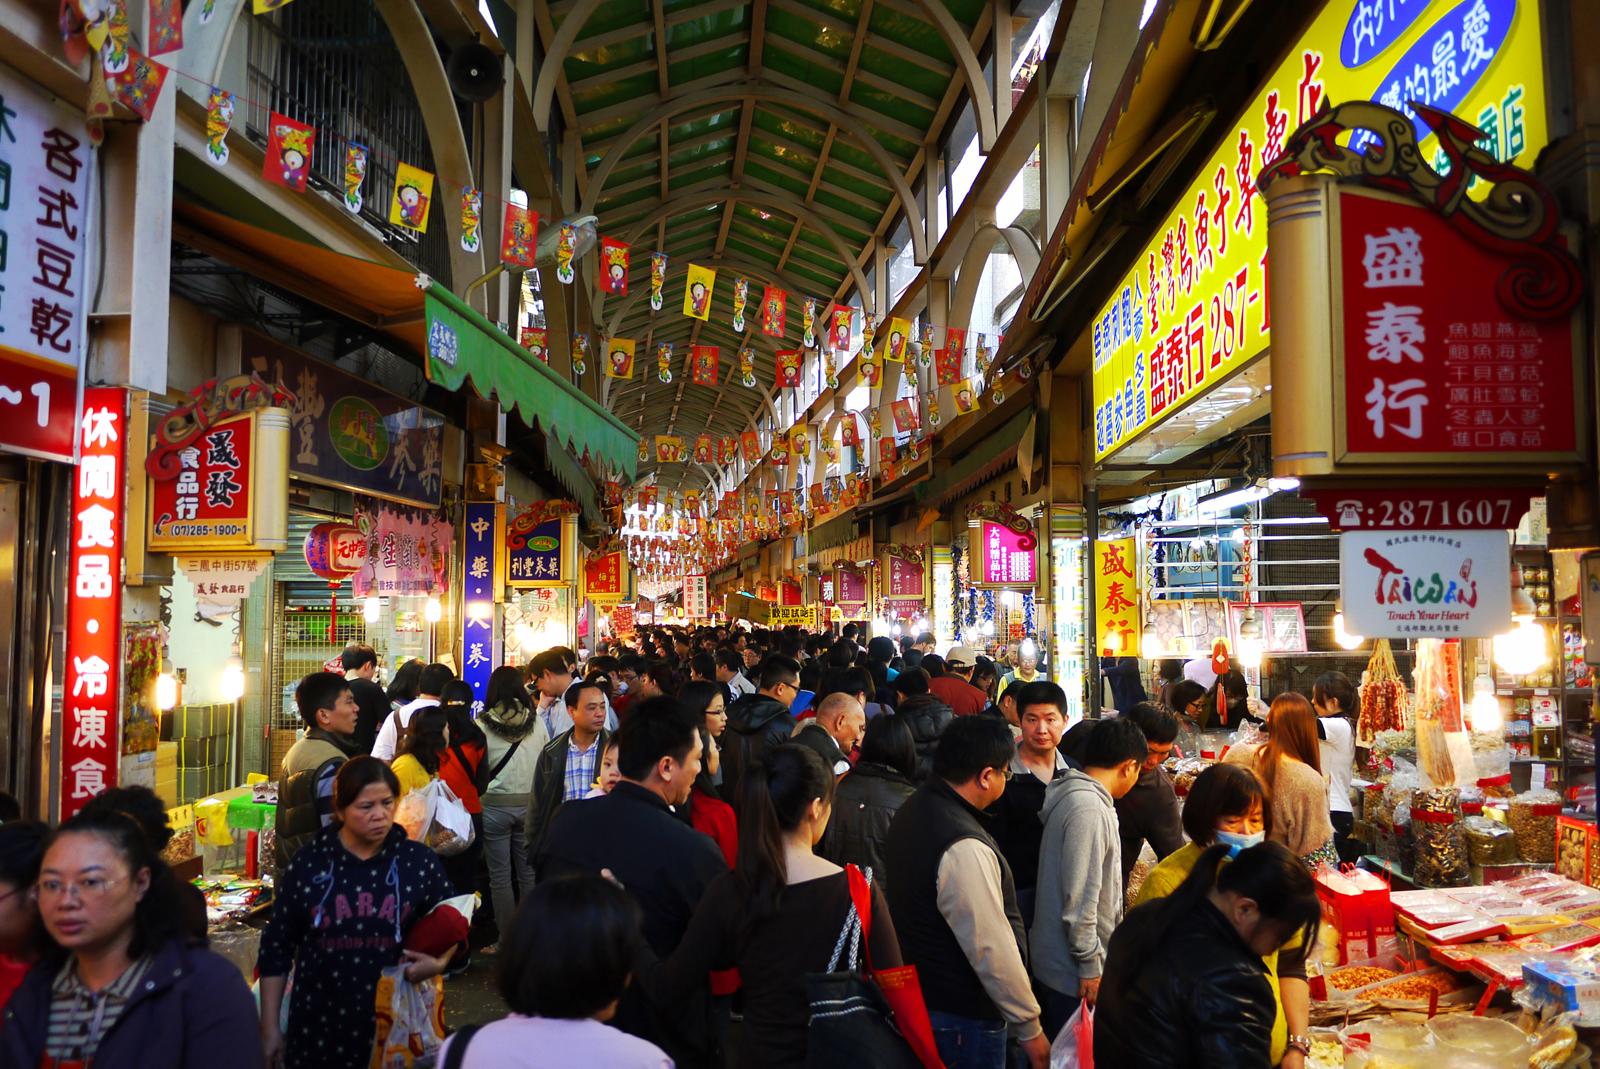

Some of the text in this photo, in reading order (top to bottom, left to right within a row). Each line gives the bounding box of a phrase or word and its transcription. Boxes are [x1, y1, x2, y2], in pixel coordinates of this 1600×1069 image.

[30, 127, 83, 353] 各式豆乾
[1150, 302, 1205, 417] 盛泰行
[1363, 227, 1428, 440] 盛泰行
[176, 446, 200, 520] 食品行
[171, 524, 247, 536] (07)285-1900-1
[188, 559, 258, 572] 三鳳中街57號
[1102, 544, 1135, 652] 盛泰行
[1385, 610, 1470, 621] Touch Your Heart
